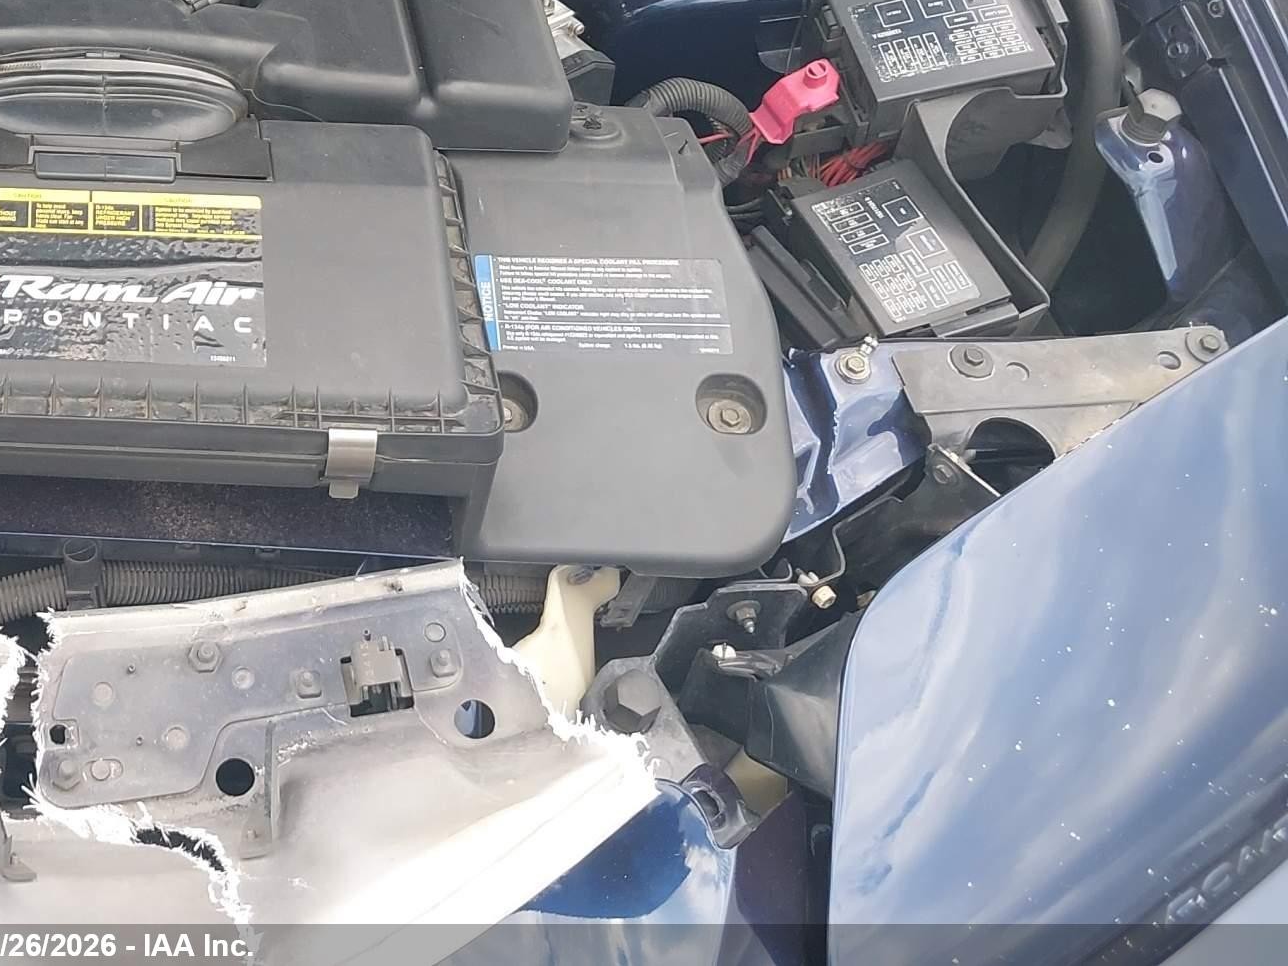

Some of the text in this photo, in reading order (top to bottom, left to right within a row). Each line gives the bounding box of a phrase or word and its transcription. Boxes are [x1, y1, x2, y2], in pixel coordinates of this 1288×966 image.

[0, 274, 258, 306] Ram Air
[481, 281, 495, 322] NOTICE
[2, 310, 253, 334] PONTIAC
